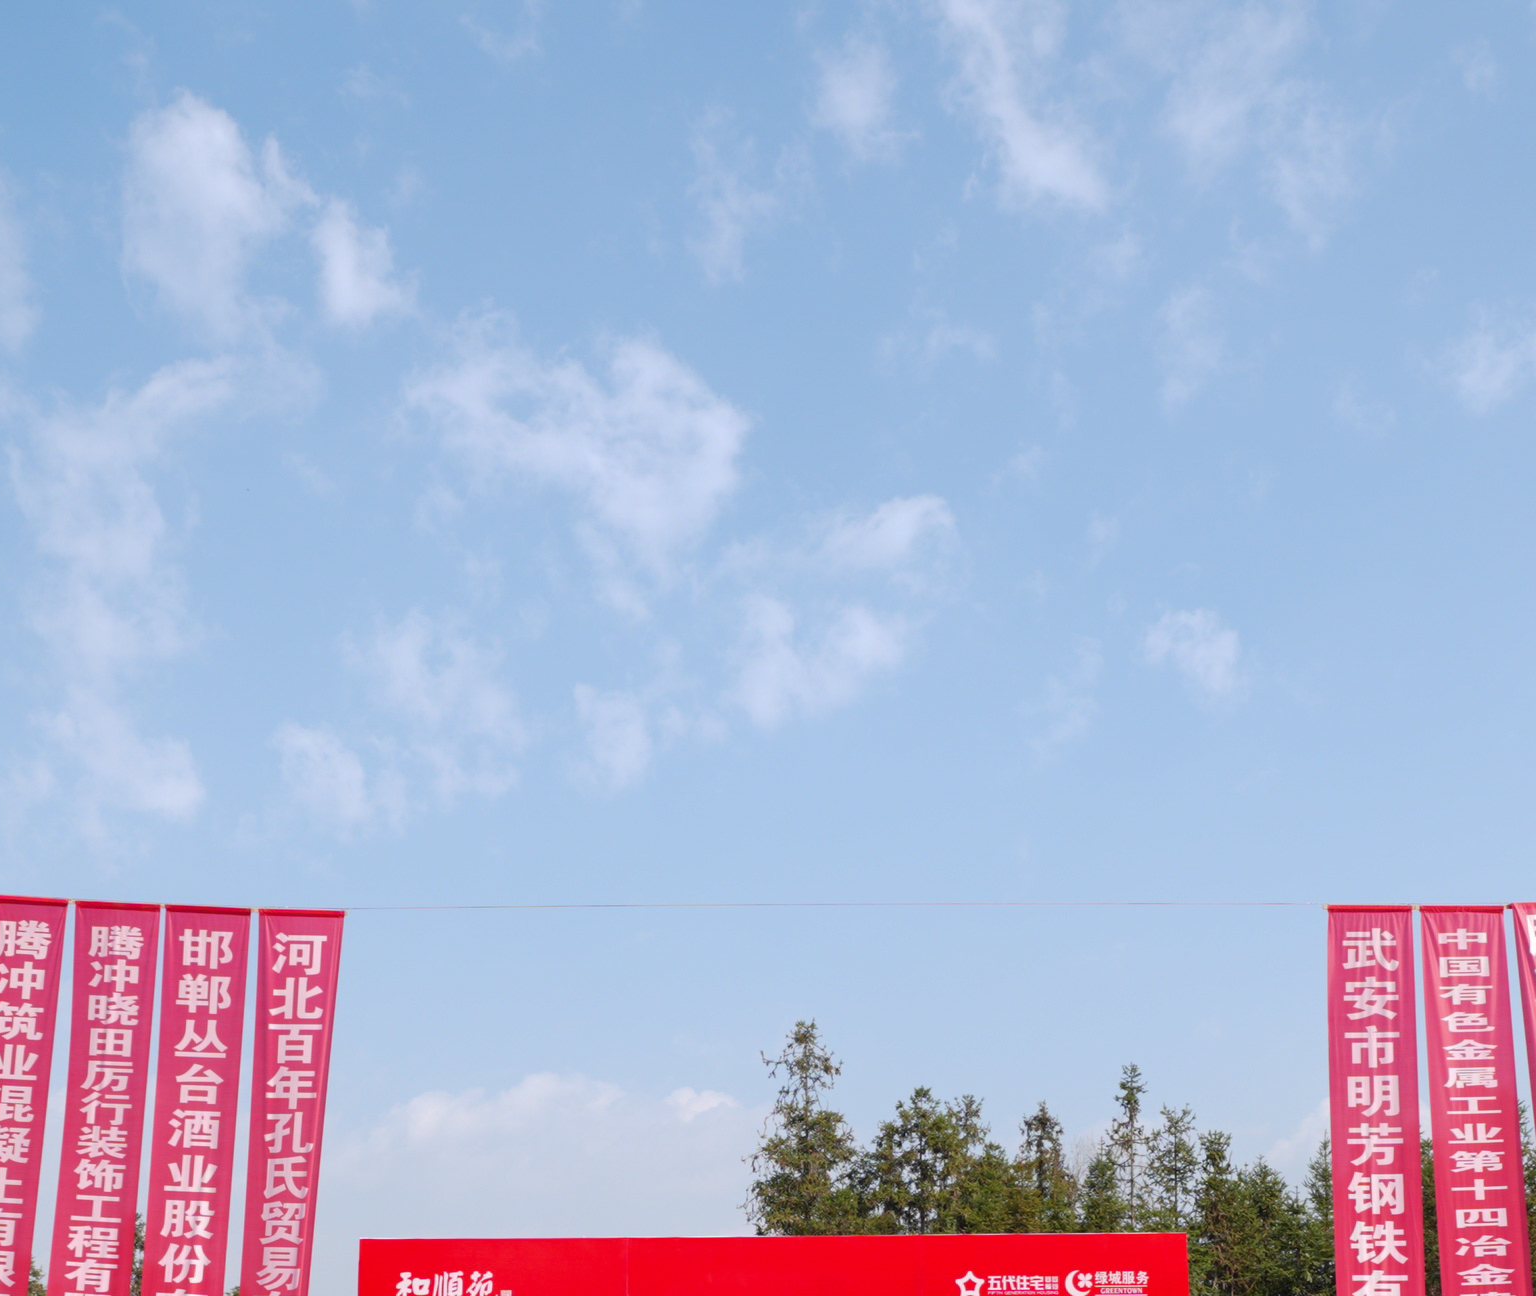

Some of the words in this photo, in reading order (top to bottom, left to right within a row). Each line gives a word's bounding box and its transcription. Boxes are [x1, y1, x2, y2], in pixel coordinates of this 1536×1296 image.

[1094, 1270, 1149, 1284] 绿城服务
[1100, 1287, 1143, 1295] GREENTOWN
